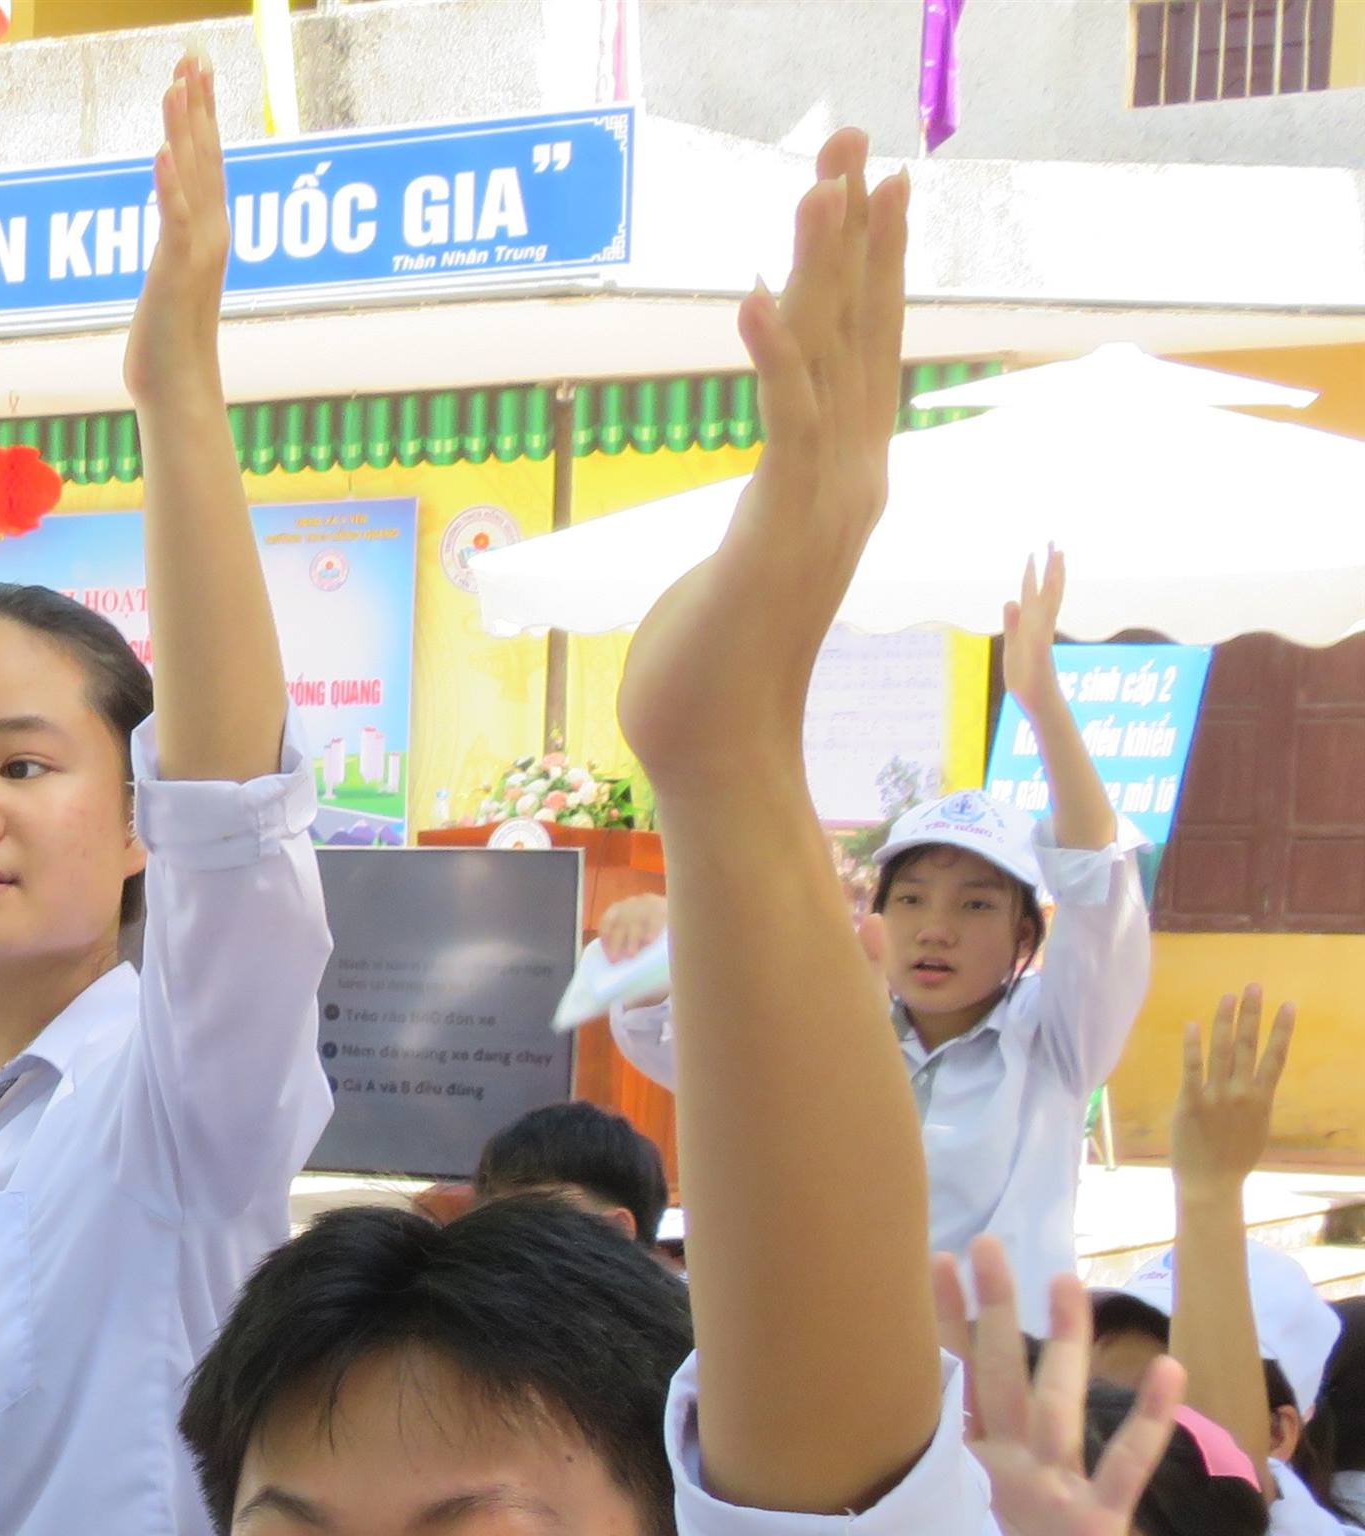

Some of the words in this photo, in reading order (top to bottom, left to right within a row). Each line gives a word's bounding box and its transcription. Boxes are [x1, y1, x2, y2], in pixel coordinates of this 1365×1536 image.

[225, 160, 378, 264] UỐC
[392, 254, 437, 273] Thân
[440, 248, 489, 267] Nhân
[494, 244, 549, 263] Trung
[330, 679, 382, 707] QUANG
[1157, 665, 1178, 704] 2
